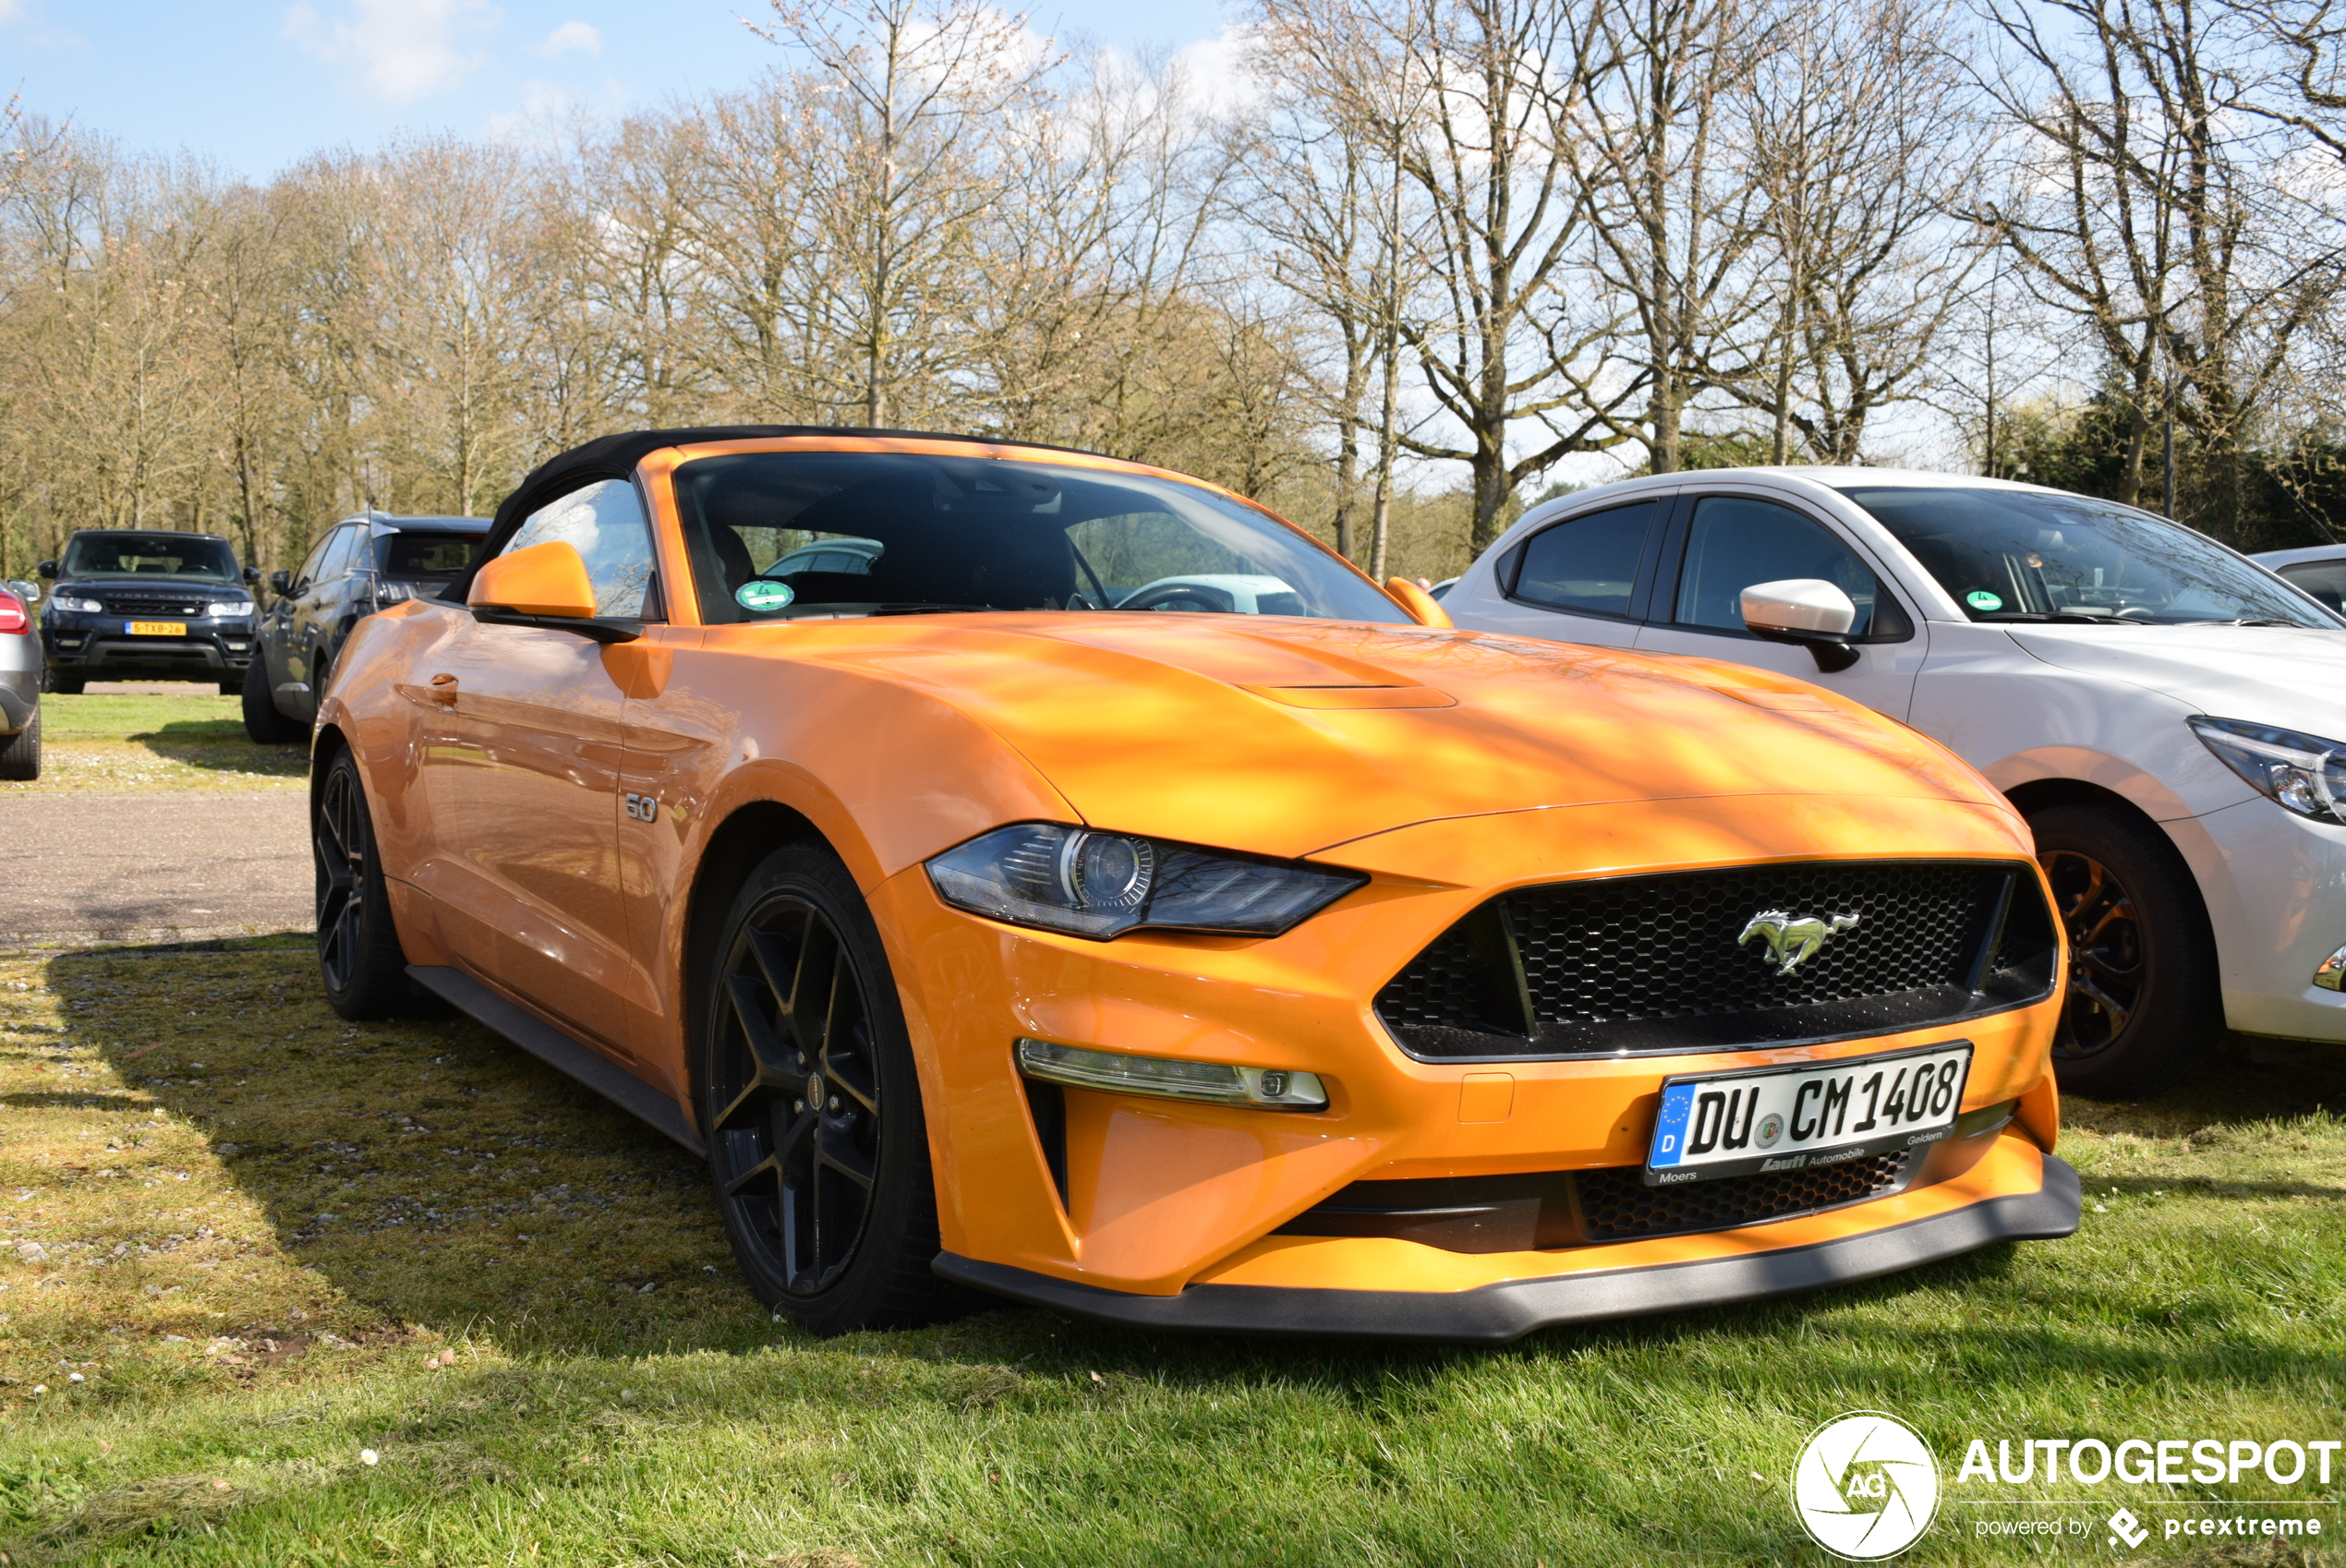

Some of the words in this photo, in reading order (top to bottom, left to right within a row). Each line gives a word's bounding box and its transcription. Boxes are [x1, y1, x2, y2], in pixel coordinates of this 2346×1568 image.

[757, 585, 770, 596] 4
[1687, 1085, 1760, 1154] DU
[1659, 1170, 1697, 1183] Moers
[1760, 1154, 1807, 1172] Lauff
[1808, 1148, 1864, 1166] Automobile
[1907, 1131, 1942, 1146] Geldern
[1662, 1135, 1675, 1152] D
